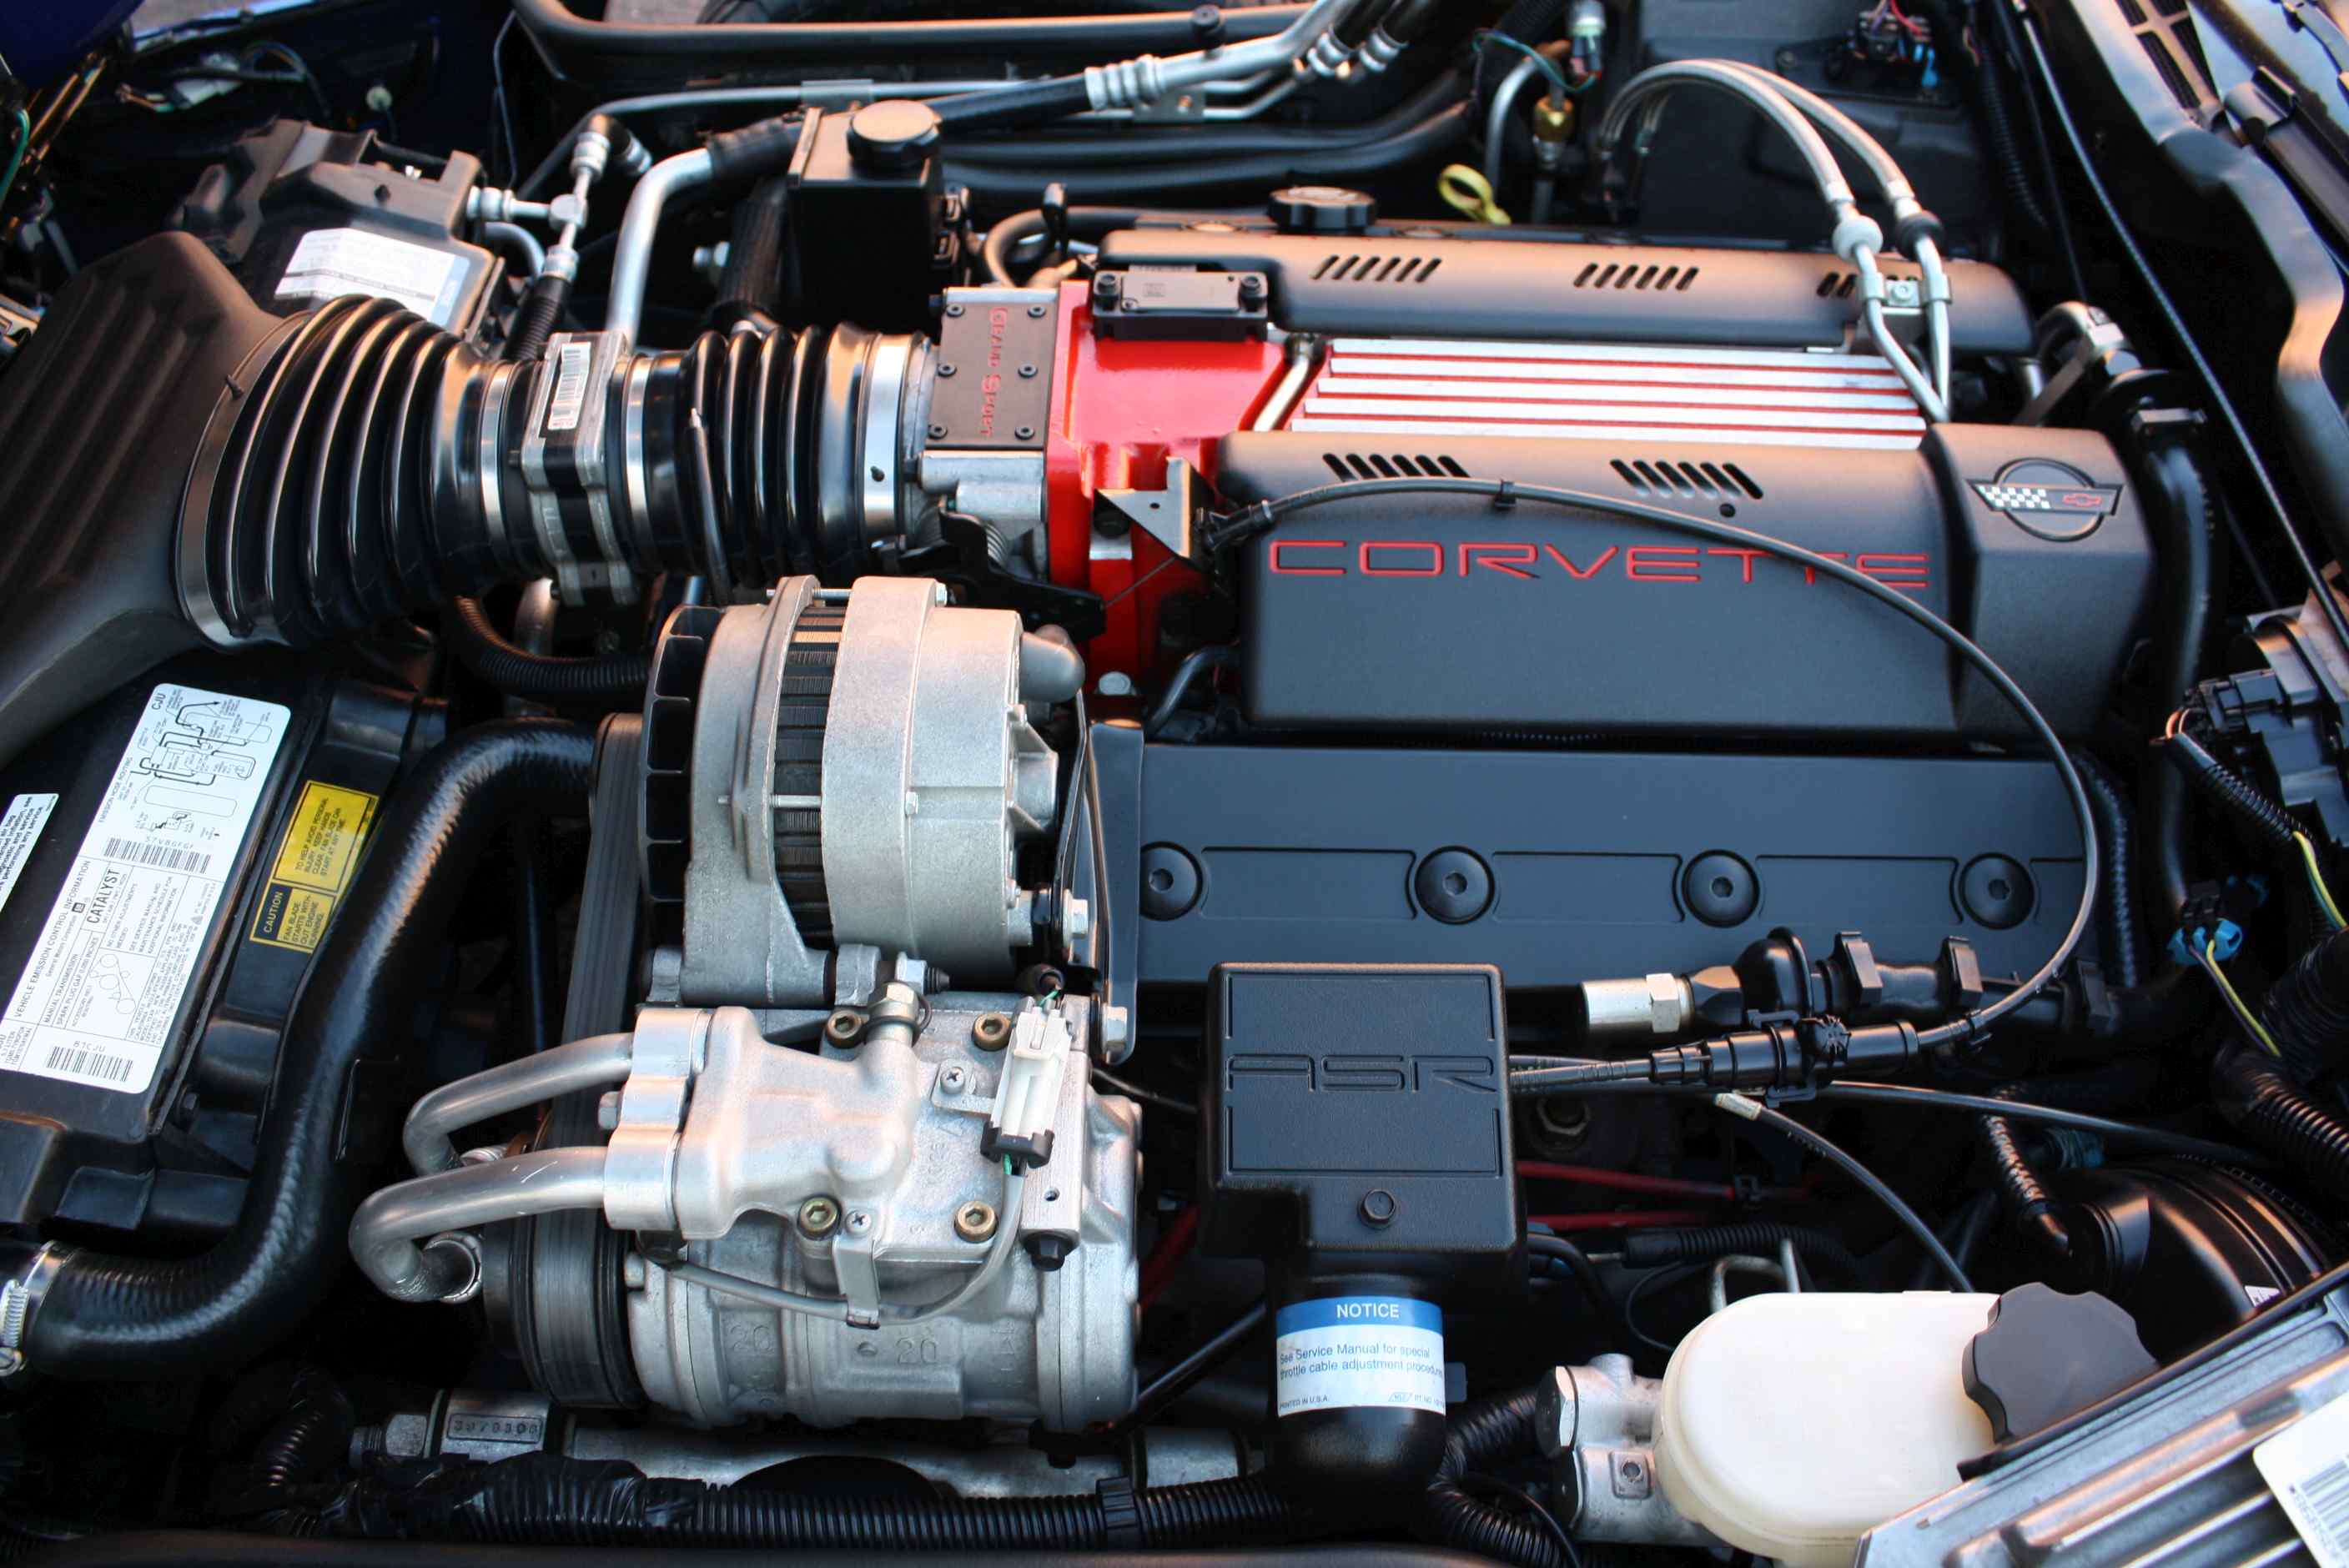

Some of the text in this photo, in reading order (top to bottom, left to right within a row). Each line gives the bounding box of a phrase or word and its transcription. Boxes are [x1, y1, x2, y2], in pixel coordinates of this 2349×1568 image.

[1270, 539, 1931, 589] CORVETTE
[151, 692, 166, 711] CJU
[87, 869, 119, 923] CATALYST
[264, 892, 283, 932] CAUTION
[14, 986, 35, 1018] VEHICLE
[30, 947, 52, 983] EMISSION
[47, 912, 68, 946] CONTROL
[63, 861, 91, 909] INFORMATION
[283, 902, 301, 941] FAN BLADE
[291, 915, 306, 942] STARTS
[299, 902, 319, 945] OUT ENGINE
[43, 954, 78, 1023] MANUAL TRANSMISSION
[56, 1006, 69, 1025] SPARK
[65, 988, 78, 1004] PLUG
[73, 974, 83, 987] GAP
[85, 937, 99, 958] INCHES
[1225, 1053, 1498, 1094] ASR
[1335, 1303, 1401, 1319] NOTICE
[1280, 1343, 1430, 1365] See Service Manual for special
[1309, 1359, 1337, 1373] cable
[1342, 1359, 1404, 1373] adjustment
